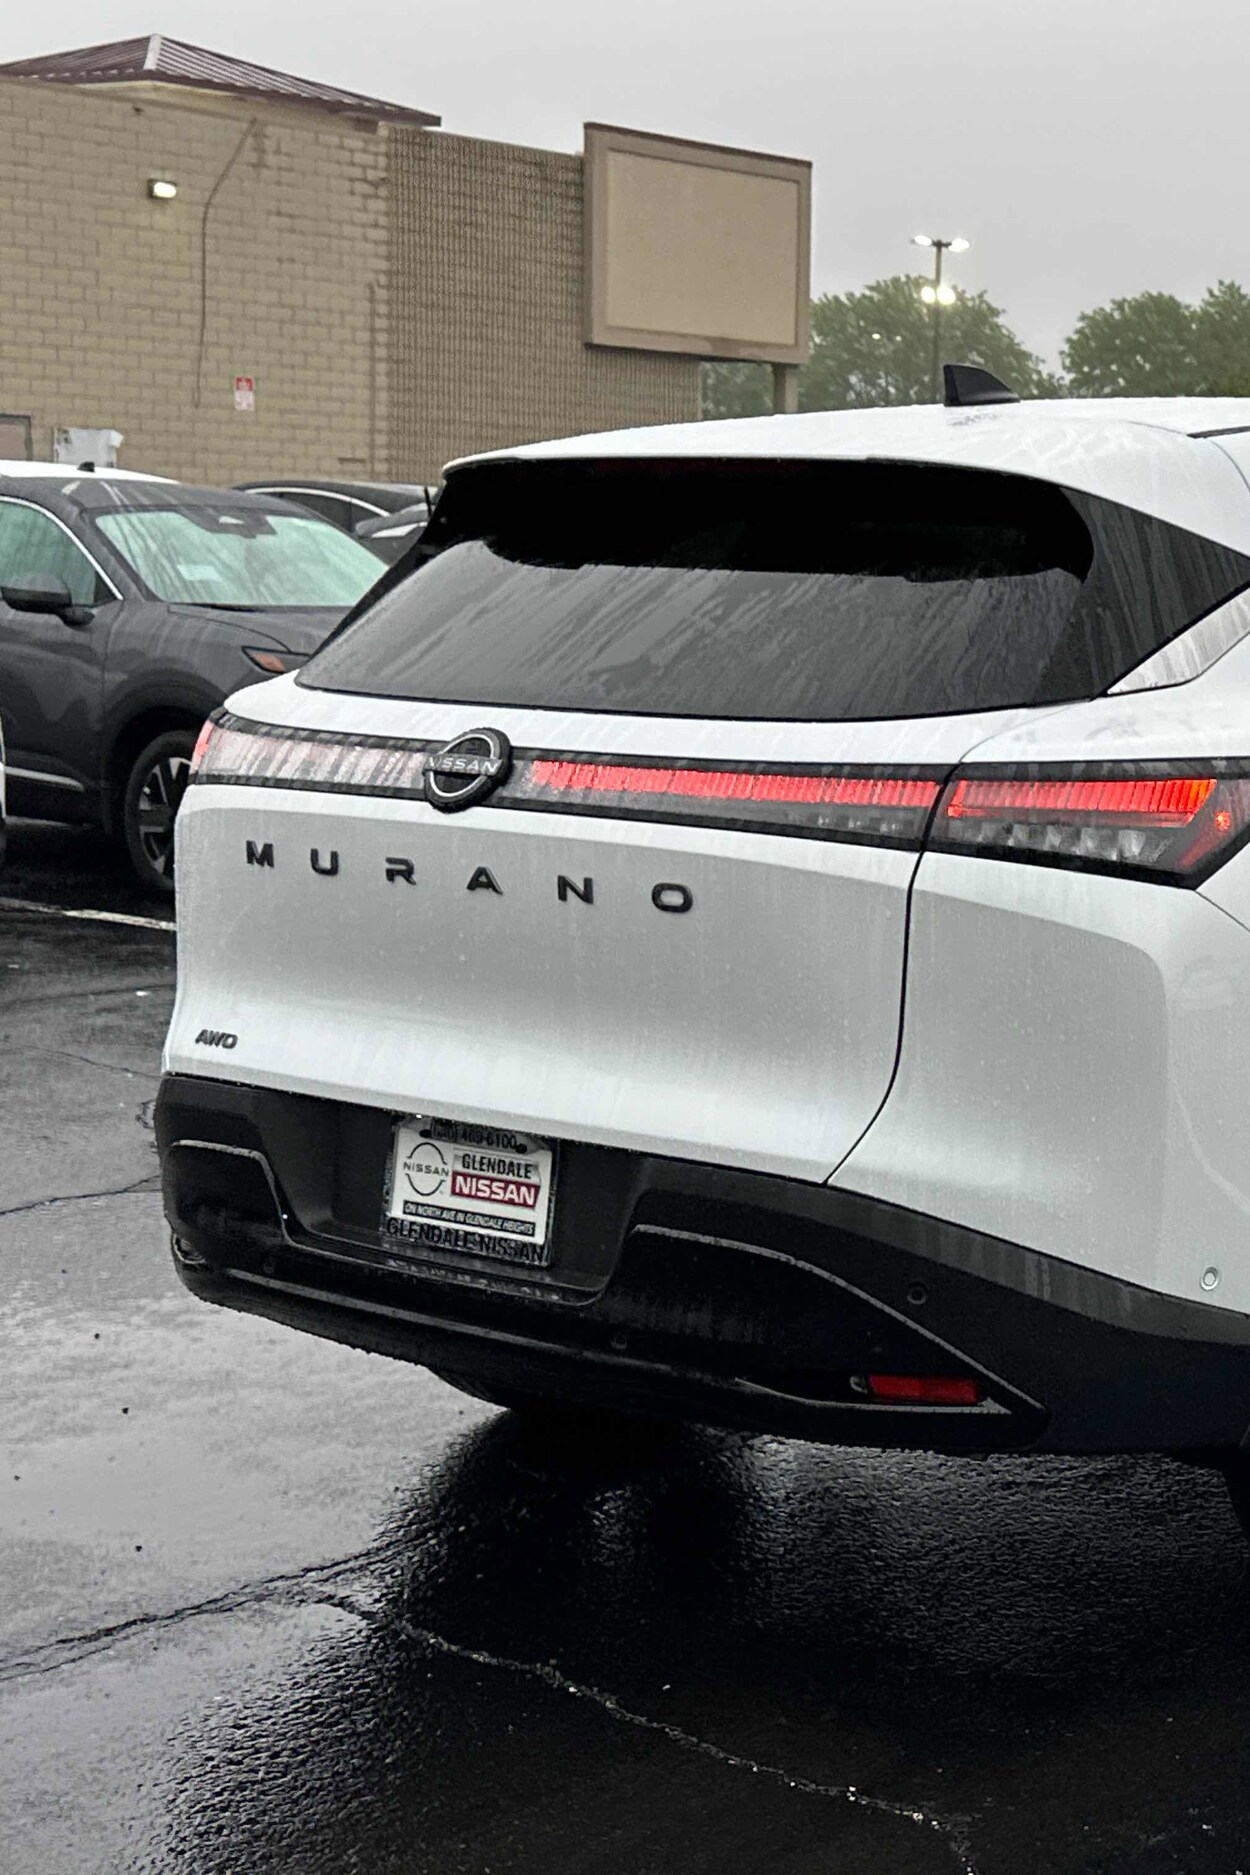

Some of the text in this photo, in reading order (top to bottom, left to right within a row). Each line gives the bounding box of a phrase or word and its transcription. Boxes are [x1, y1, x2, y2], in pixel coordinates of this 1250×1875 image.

[246, 840, 694, 913] MURANO
[195, 1029, 238, 1049] AWD
[403, 1161, 449, 1177] NISSAN
[461, 1153, 533, 1179] GLENDALE
[455, 1175, 536, 1206] NISSAN
